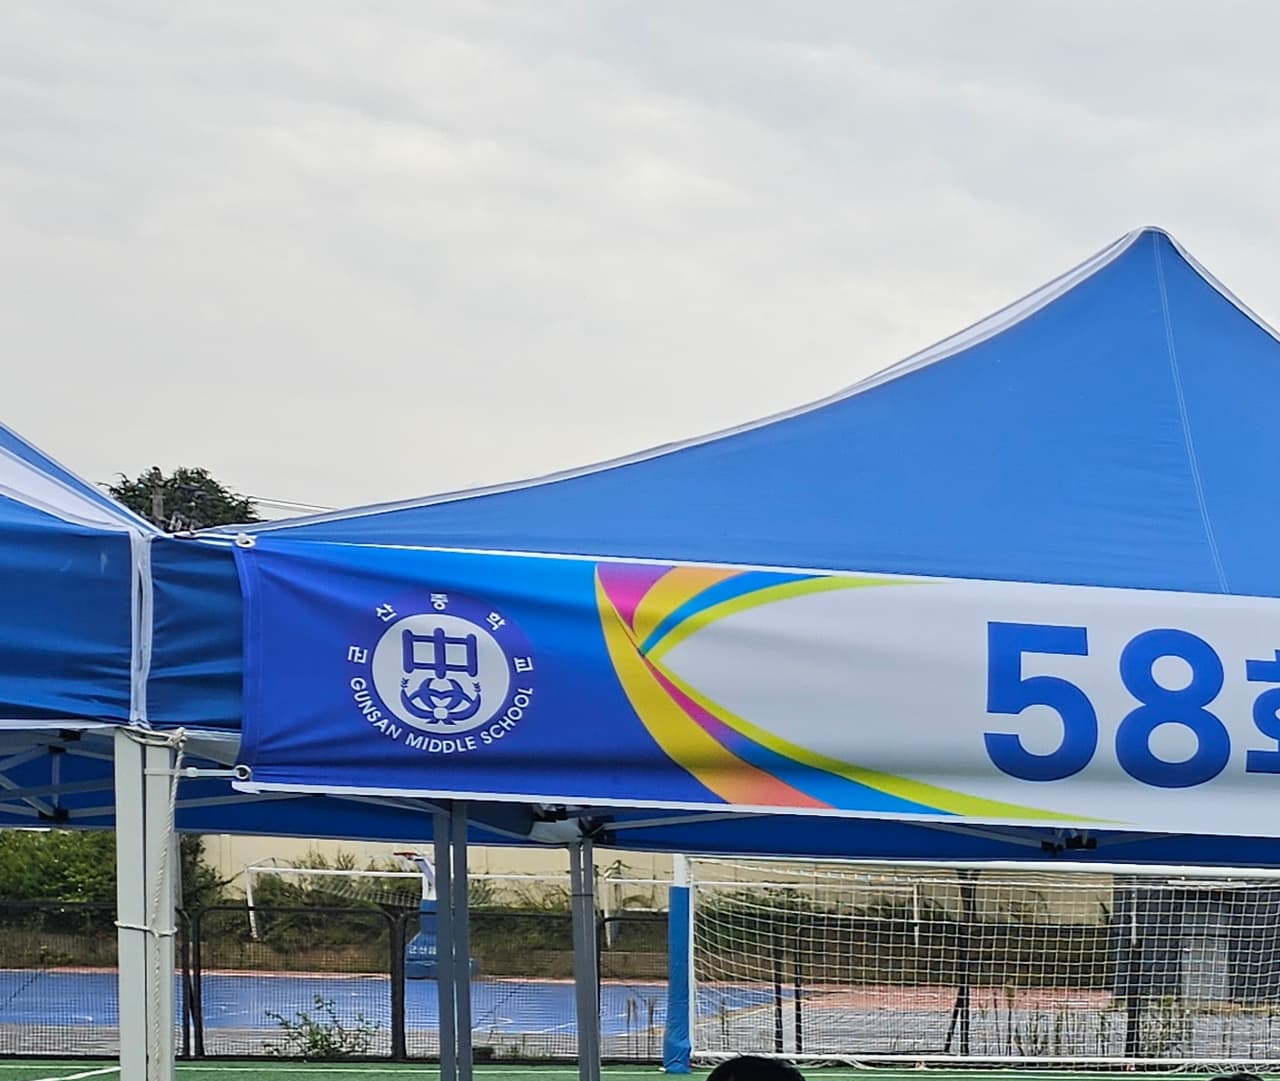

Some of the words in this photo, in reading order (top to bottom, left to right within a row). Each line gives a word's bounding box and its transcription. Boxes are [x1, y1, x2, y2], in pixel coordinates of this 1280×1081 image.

[350, 677, 402, 739] GUNSAN
[405, 732, 477, 754] MIDDLE
[480, 686, 534, 744] SCHOOL
